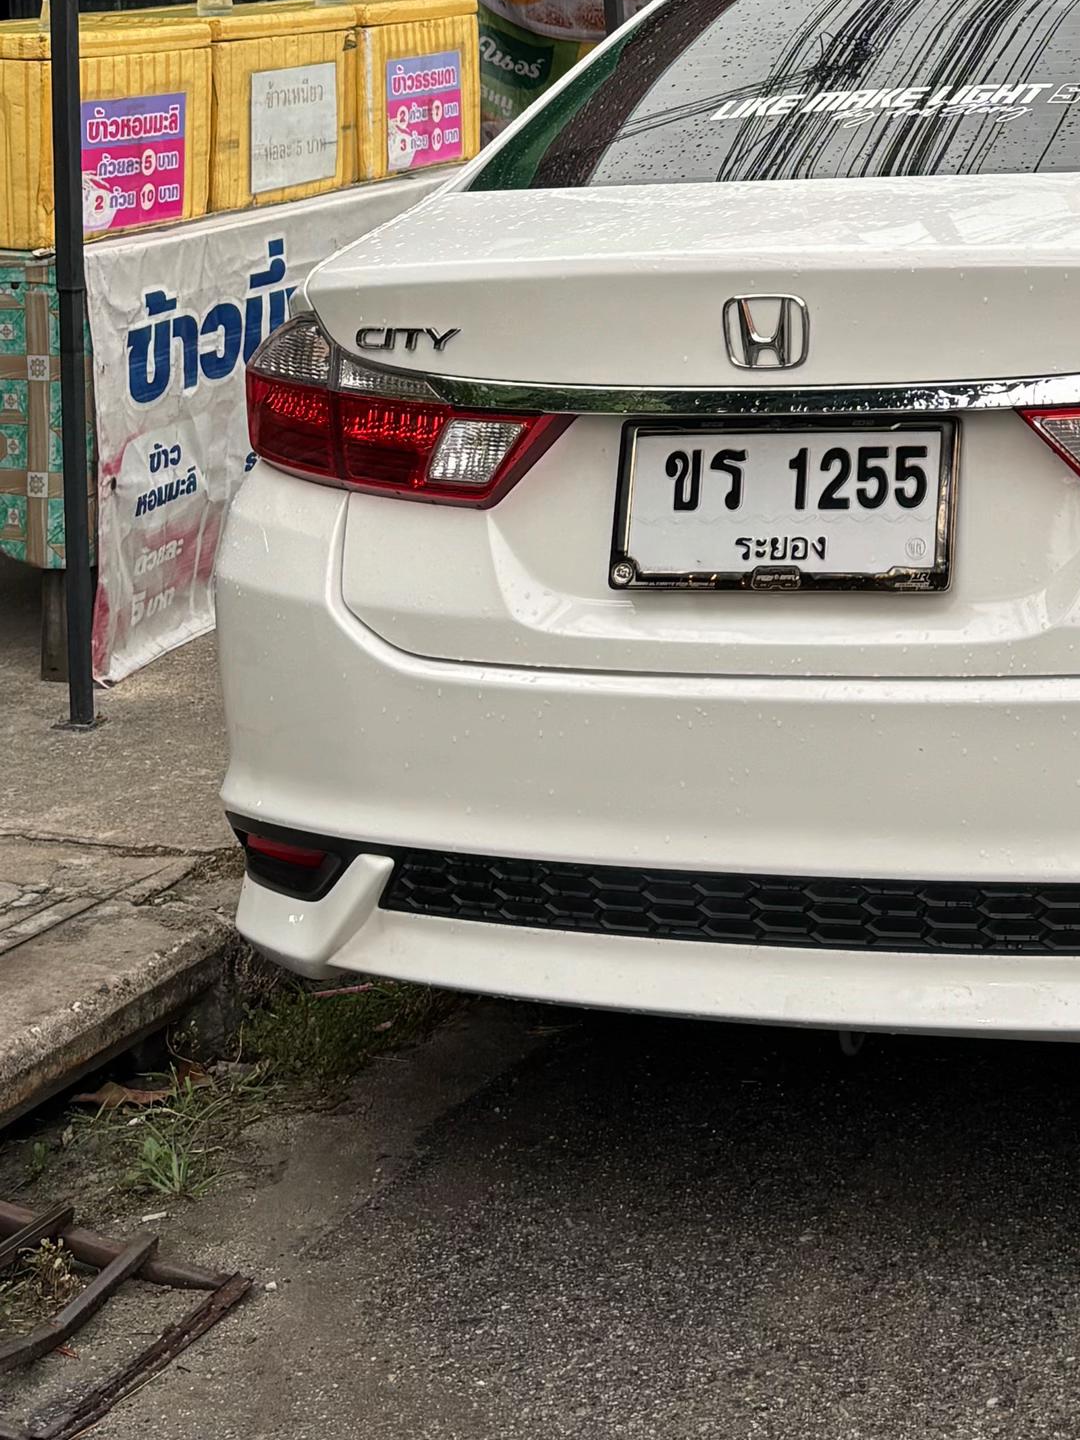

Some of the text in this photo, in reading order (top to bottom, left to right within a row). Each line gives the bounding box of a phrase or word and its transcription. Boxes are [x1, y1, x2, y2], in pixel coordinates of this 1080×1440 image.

[265, 77, 325, 109] ข้าวเหนียว
[391, 64, 457, 95] ข้าวธรรมดา
[709, 94, 806, 121] LIKE
[802, 86, 931, 113] MAKE
[926, 83, 1055, 106] LIGHT
[87, 105, 180, 142] ข้าวหอมมะลิ
[157, 151, 179, 170] บาท
[94, 194, 105, 211] 2
[140, 188, 155, 204] 10
[159, 184, 180, 204] บาท
[127, 238, 298, 404] ข้าวนึ่
[355, 327, 462, 352] CITY
[149, 442, 182, 474] ข้าว
[135, 465, 198, 518] หอมมะลิ
[664, 444, 929, 512] ขร 1255
[733, 534, 828, 562] ระยอง
